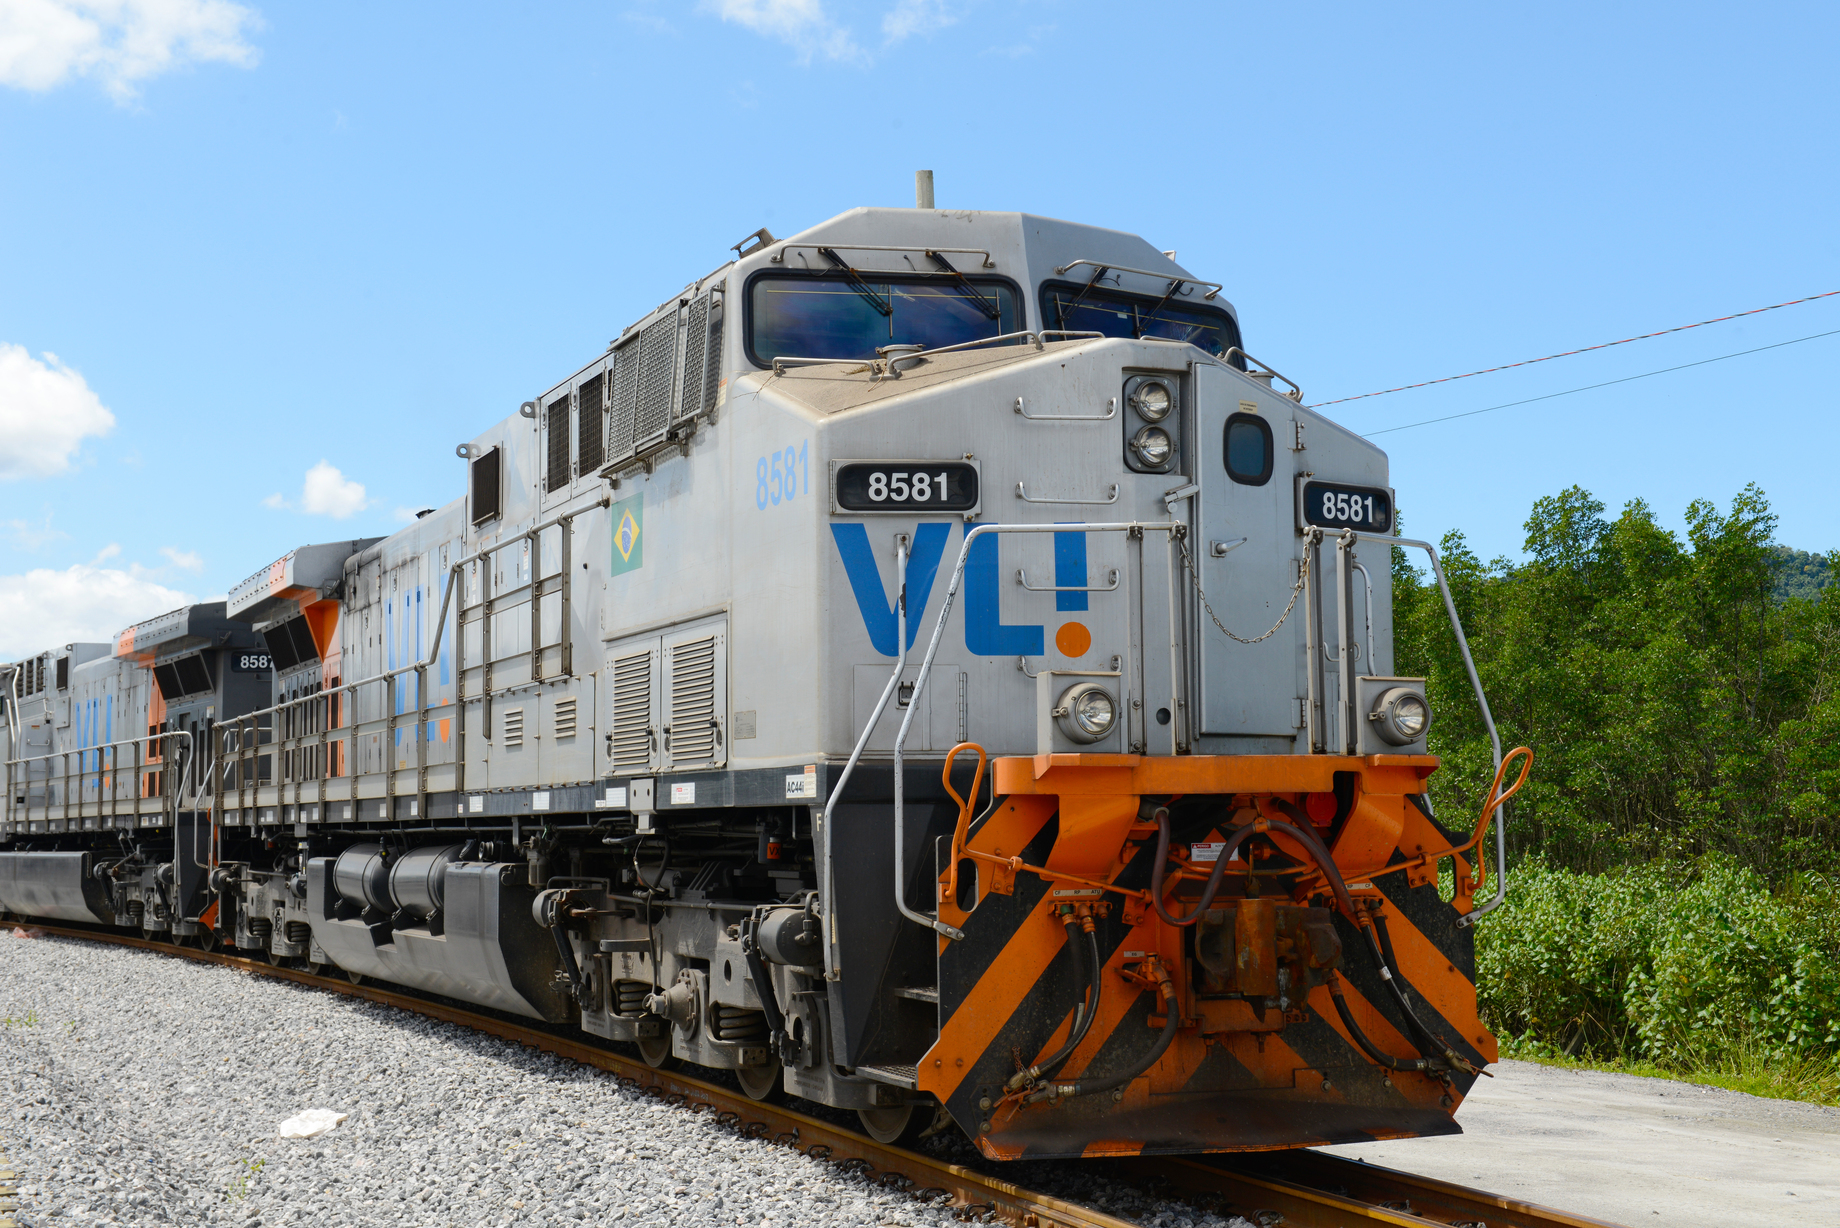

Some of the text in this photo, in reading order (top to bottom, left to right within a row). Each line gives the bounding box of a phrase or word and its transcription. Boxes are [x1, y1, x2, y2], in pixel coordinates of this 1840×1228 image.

[756, 438, 808, 511] 8581
[868, 472, 948, 502] 8581
[1322, 491, 1373, 523] 8581
[816, 813, 822, 832] F
